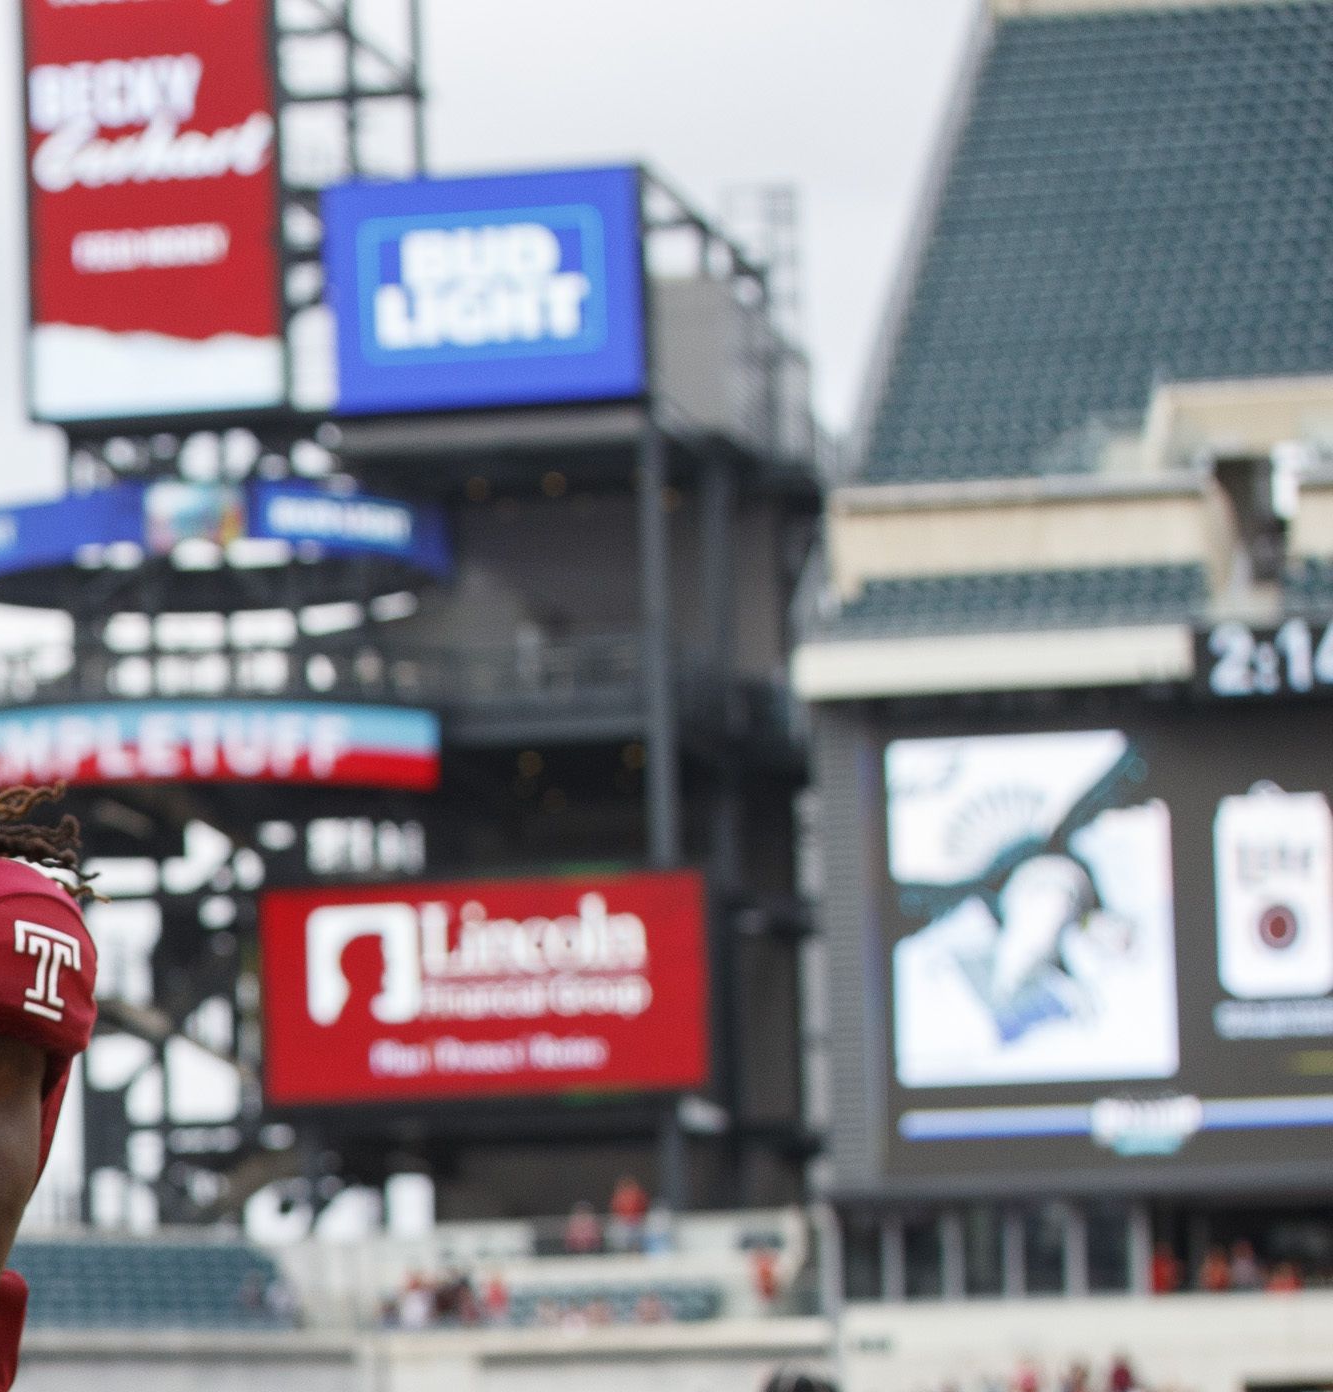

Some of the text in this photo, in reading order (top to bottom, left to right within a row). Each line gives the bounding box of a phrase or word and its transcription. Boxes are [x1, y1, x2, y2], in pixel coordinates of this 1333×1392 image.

[400, 222, 561, 285] BUD
[374, 273, 590, 350] LIGHT
[14, 921, 82, 1023] T
[420, 892, 648, 976] Lincoln
